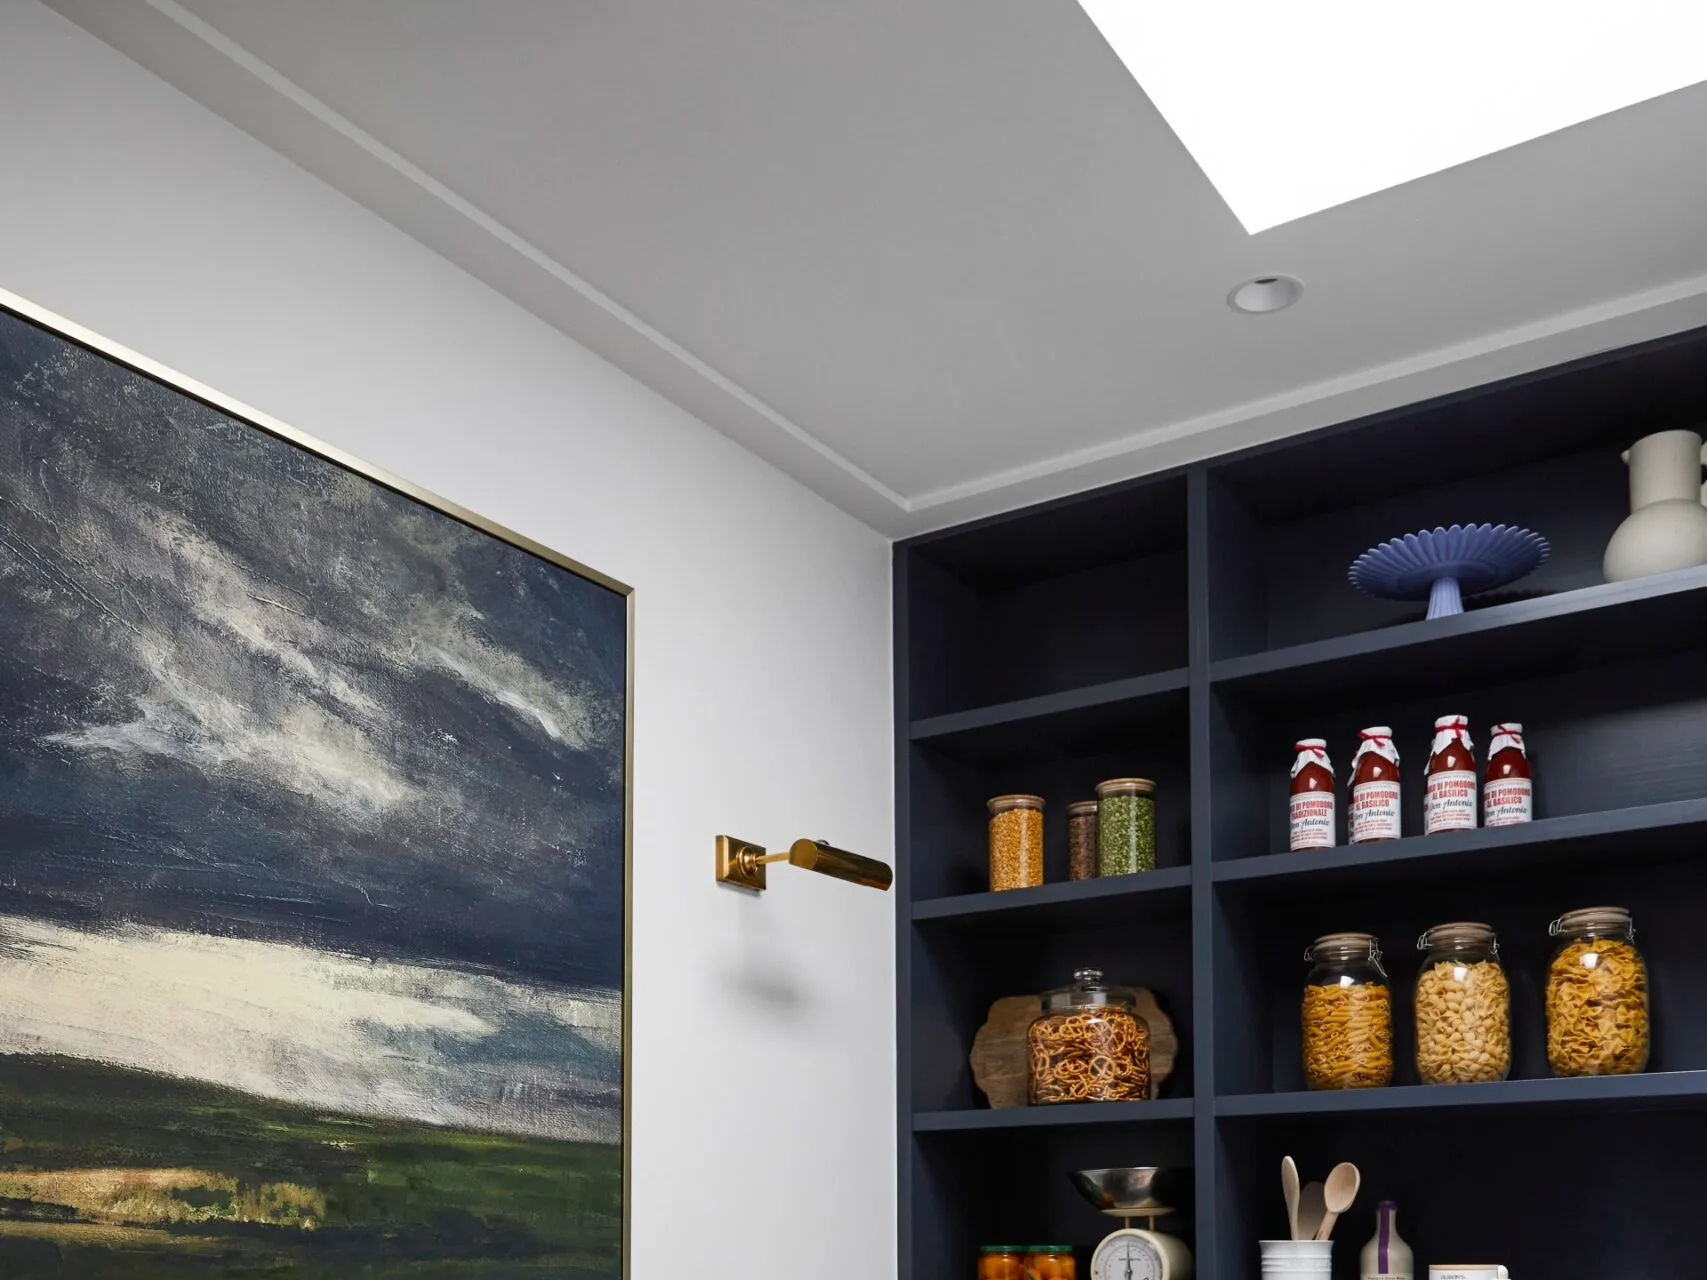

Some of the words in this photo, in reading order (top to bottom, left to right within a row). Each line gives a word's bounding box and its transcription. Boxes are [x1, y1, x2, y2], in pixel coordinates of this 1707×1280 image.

[1437, 782, 1443, 791] DI
[1360, 793, 1365, 802] DI
[1439, 789, 1467, 798] BASILICO
[1491, 790, 1497, 799] DI
[1362, 799, 1389, 809] BASILICO
[1493, 796, 1521, 806] BASILICO
[1296, 802, 1301, 810] DI
